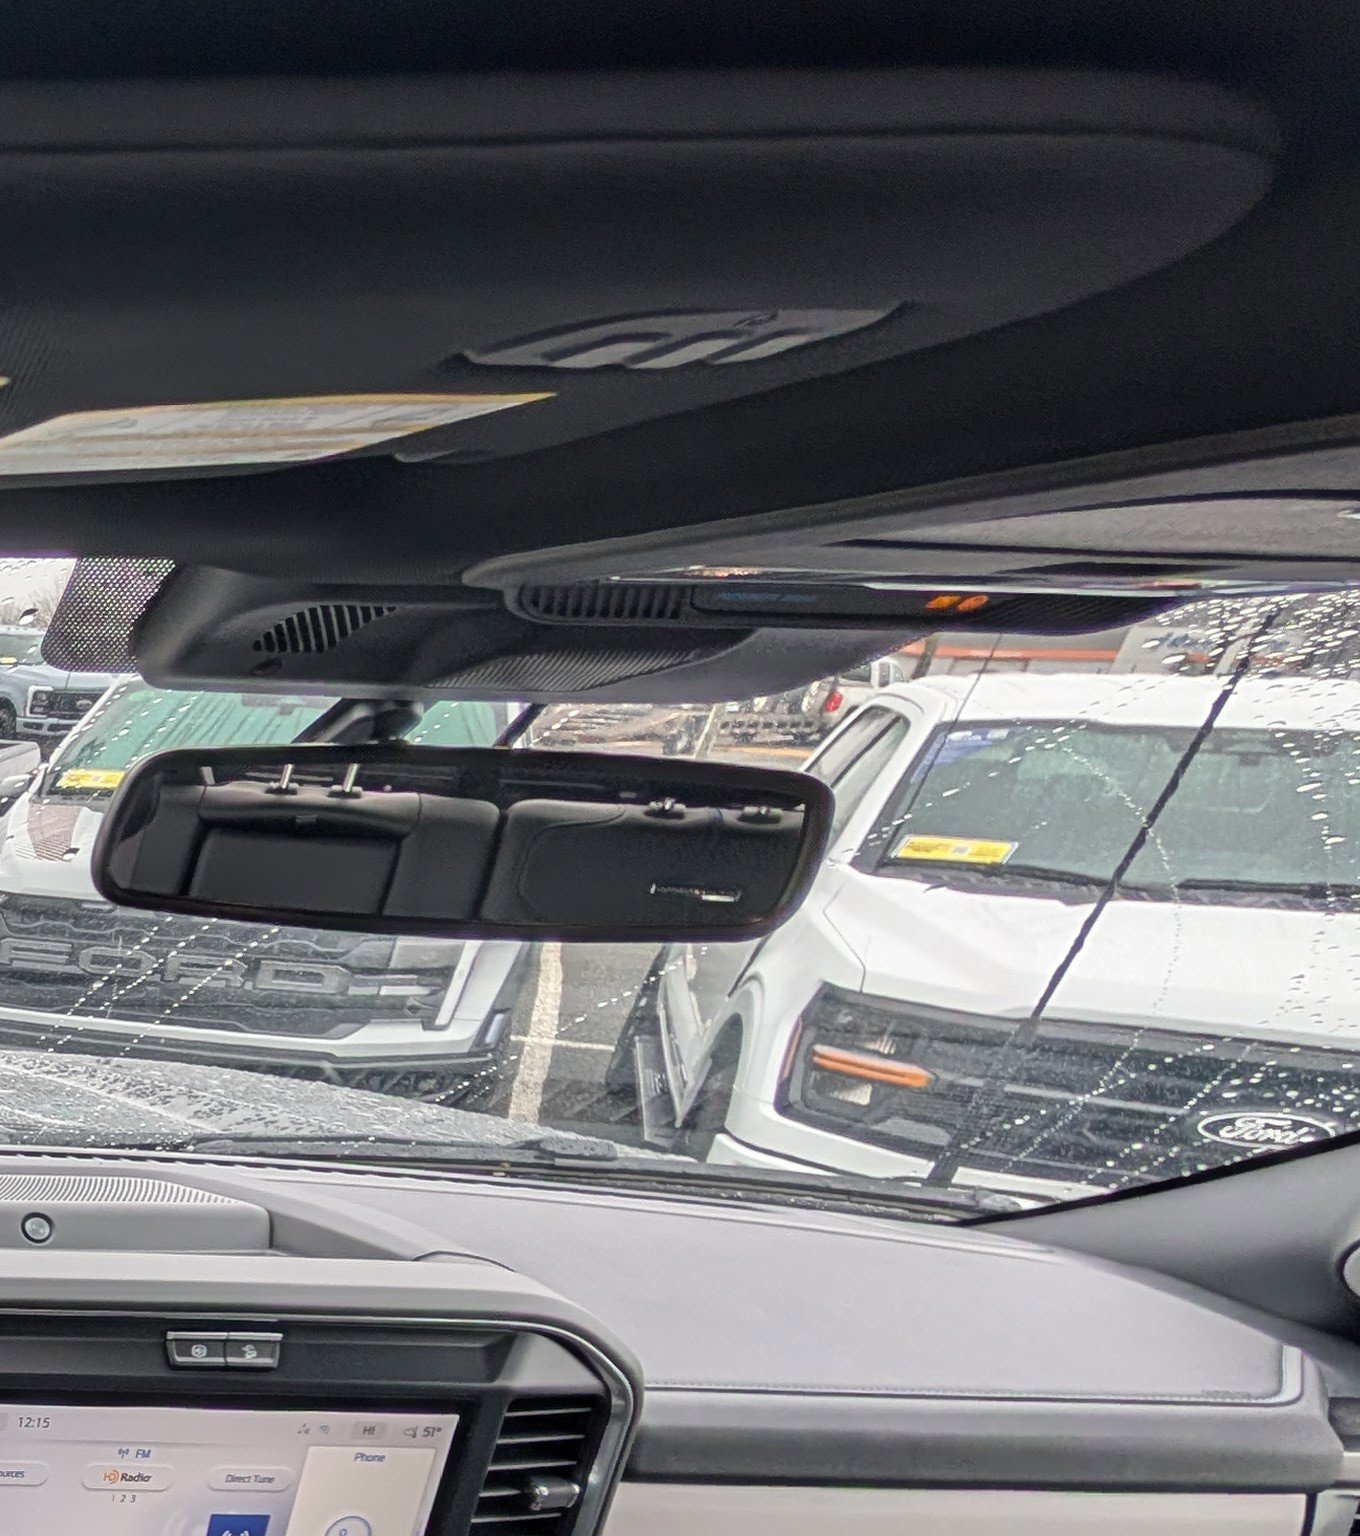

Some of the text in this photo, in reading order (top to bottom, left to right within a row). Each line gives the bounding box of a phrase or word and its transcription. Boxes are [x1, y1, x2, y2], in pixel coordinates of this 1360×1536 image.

[1218, 1116, 1311, 1145] Ford
[18, 1416, 51, 1429] 12:15
[135, 1449, 151, 1459] FM
[353, 1452, 386, 1462] Phone
[120, 1472, 152, 1483] Radio
[225, 1474, 276, 1485] Direct Tune
